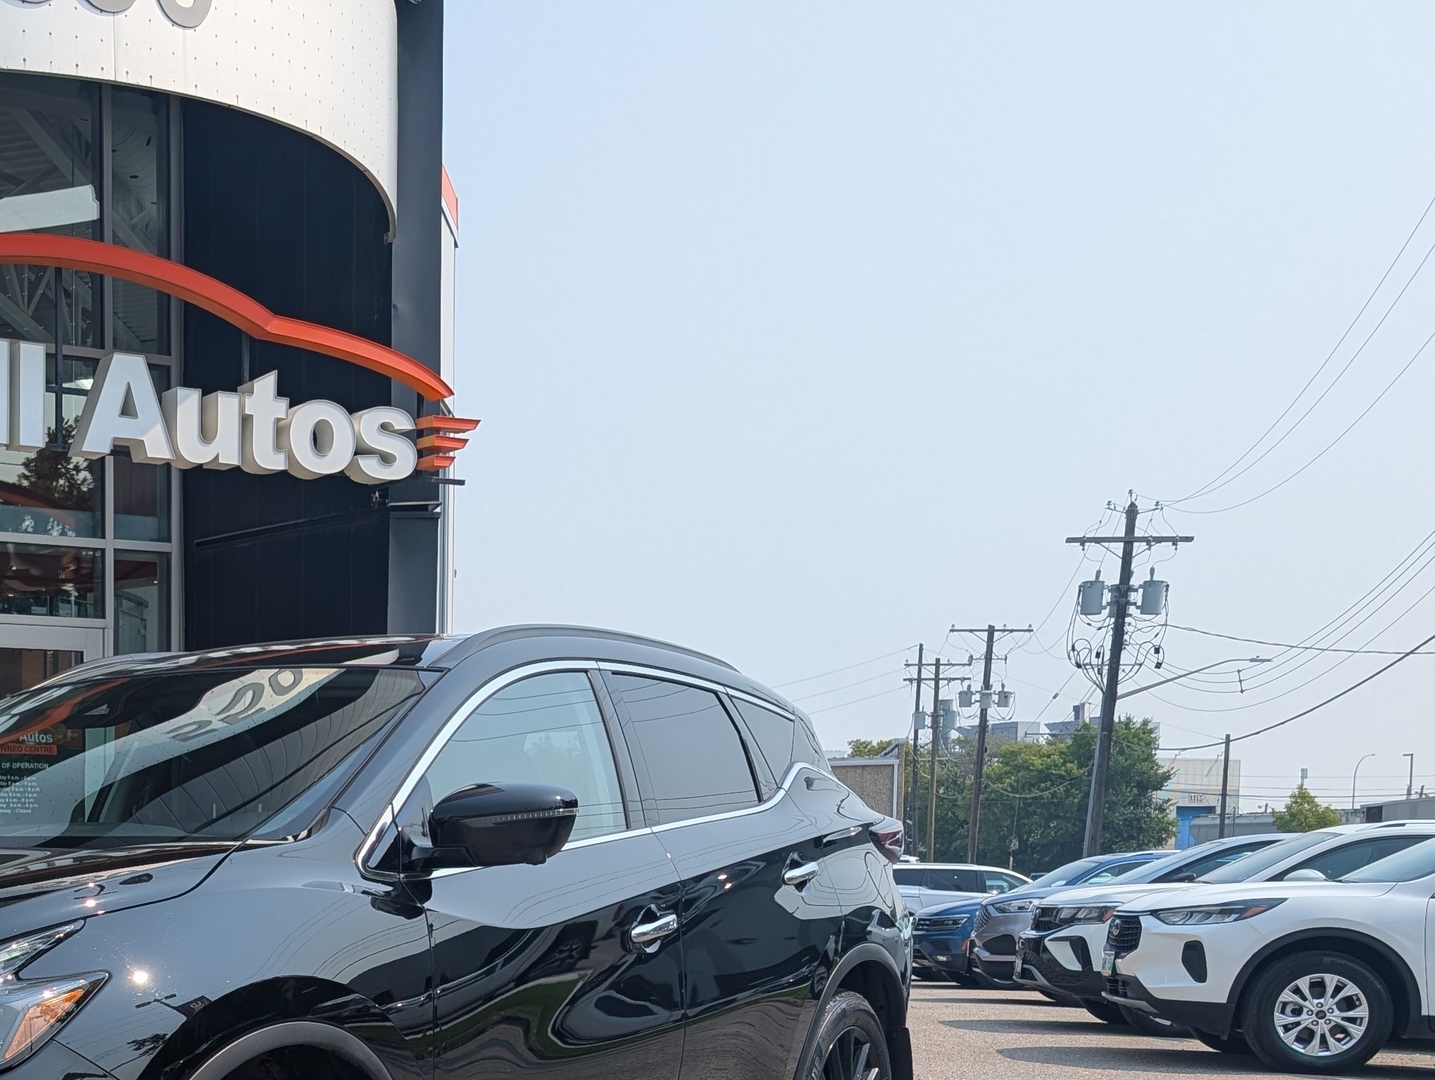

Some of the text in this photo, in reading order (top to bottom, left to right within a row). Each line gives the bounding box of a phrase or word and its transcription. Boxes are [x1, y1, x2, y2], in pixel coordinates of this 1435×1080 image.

[69, 350, 418, 485] Autos
[1, 761, 11, 769] OF
[12, 761, 49, 770] OPERATION
